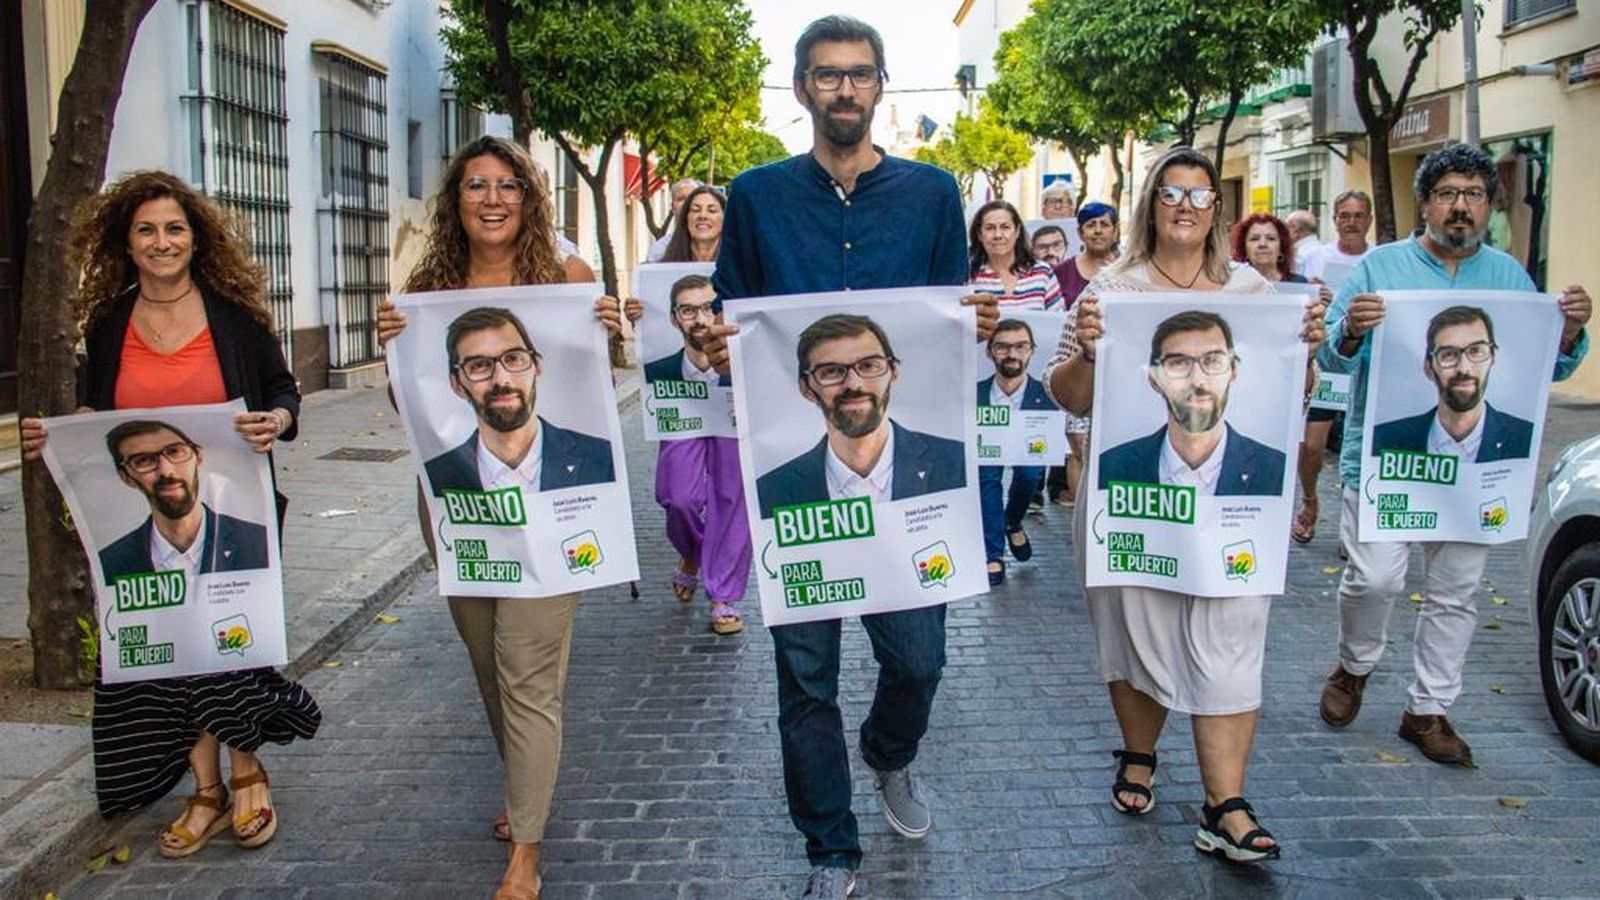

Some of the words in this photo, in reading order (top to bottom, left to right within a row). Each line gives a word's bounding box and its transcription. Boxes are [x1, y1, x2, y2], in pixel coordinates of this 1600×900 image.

[655, 380, 706, 398] BUENO
[977, 407, 1008, 425] UENO
[1382, 453, 1455, 482] BUENO
[446, 491, 522, 524] BUENO
[1112, 485, 1192, 521] BUENO
[1379, 495, 1406, 509] PARA
[778, 501, 870, 544] BUENO
[1379, 514, 1391, 527] EL
[1393, 513, 1435, 528] PUERTO
[456, 541, 486, 557] PARA
[1109, 533, 1141, 550] PARA
[459, 562, 473, 579] EL
[474, 562, 520, 580] PUERTO
[783, 562, 820, 584] PARA
[1110, 554, 1125, 570] EL
[1127, 554, 1176, 576] PUERTO
[118, 573, 184, 609] BUENO
[786, 588, 805, 607] EL
[806, 579, 863, 605] PUERTO
[120, 627, 146, 645] PARA
[121, 649, 133, 666] EL
[134, 645, 173, 665] PUERTO
